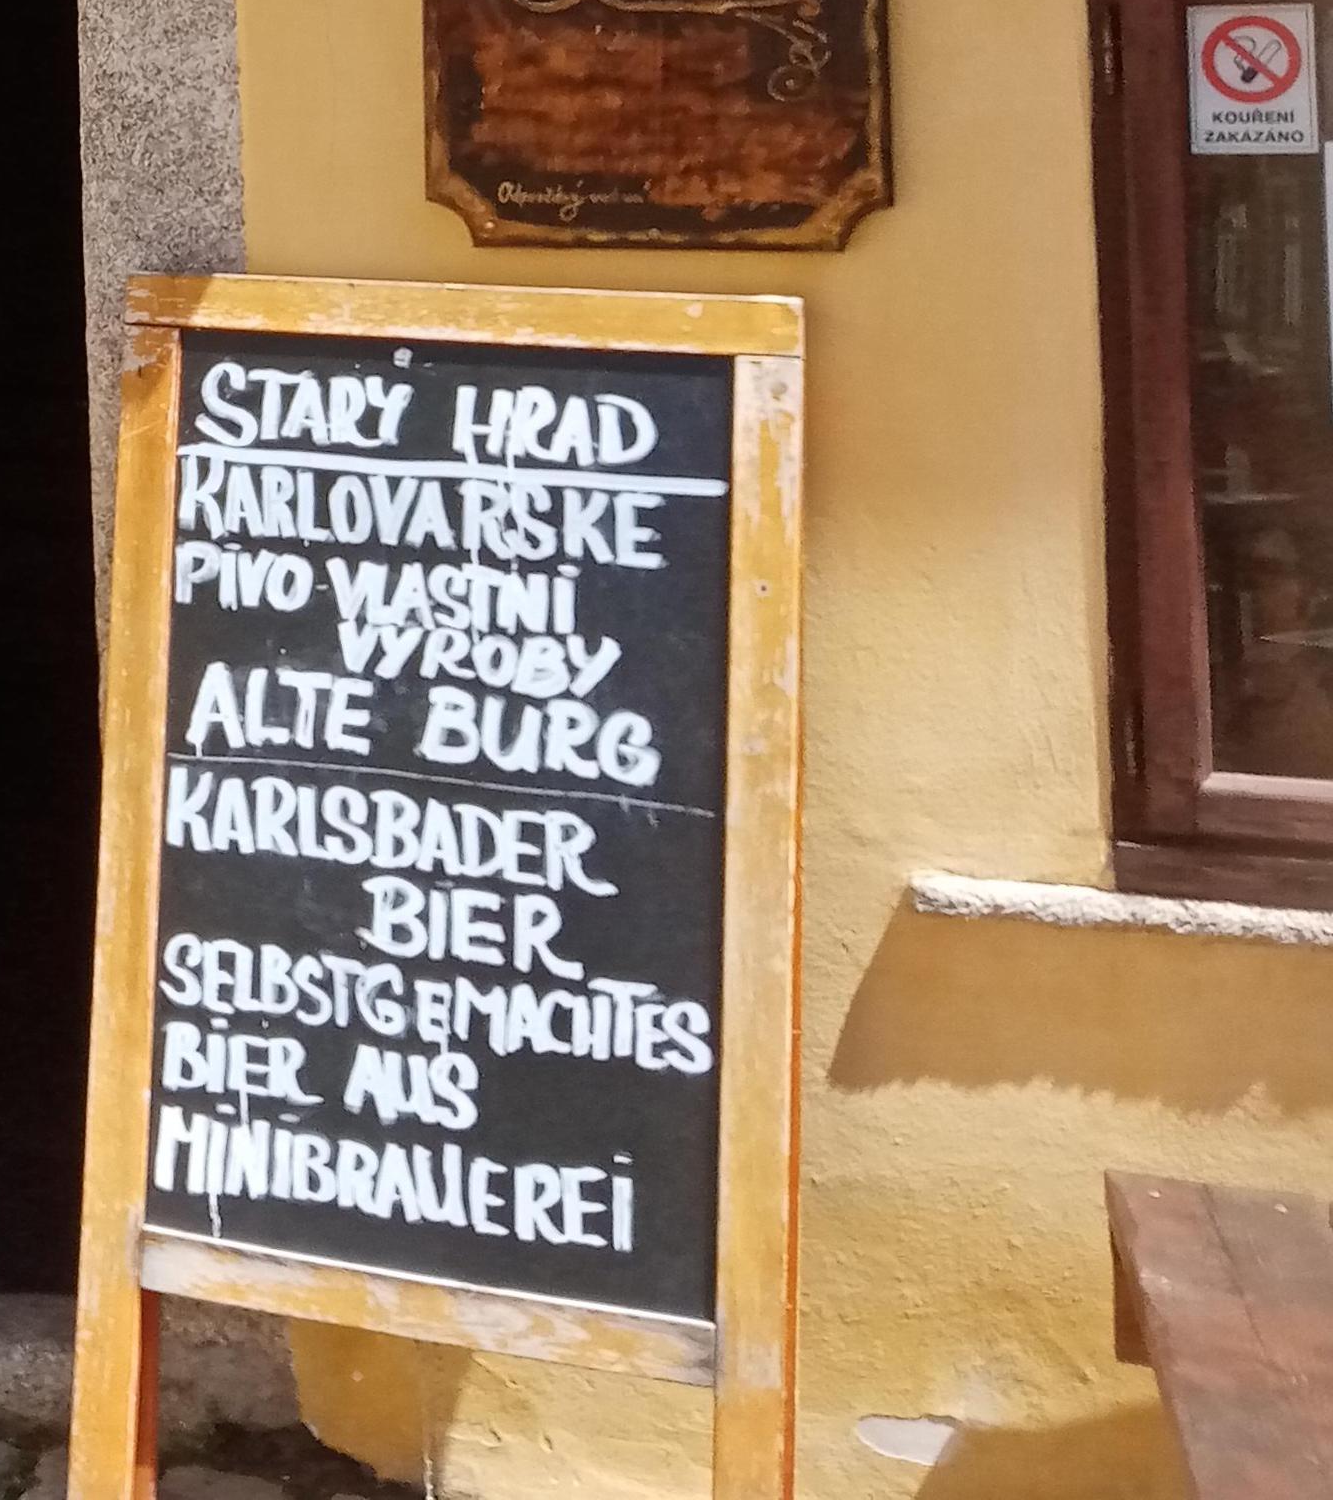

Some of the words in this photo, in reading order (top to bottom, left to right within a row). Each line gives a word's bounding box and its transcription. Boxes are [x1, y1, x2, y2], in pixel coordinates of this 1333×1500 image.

[1204, 128, 1305, 144] ZAKÁZÁNO
[1211, 108, 1296, 125] KOUŘENÍ
[453, 384, 660, 467] HRAD
[338, 620, 621, 698] VYROBY
[186, 662, 374, 755] ALTE
[421, 686, 661, 786] BURG
[165, 767, 619, 897] KARLSBADER
[344, 1044, 480, 1130] AUS
